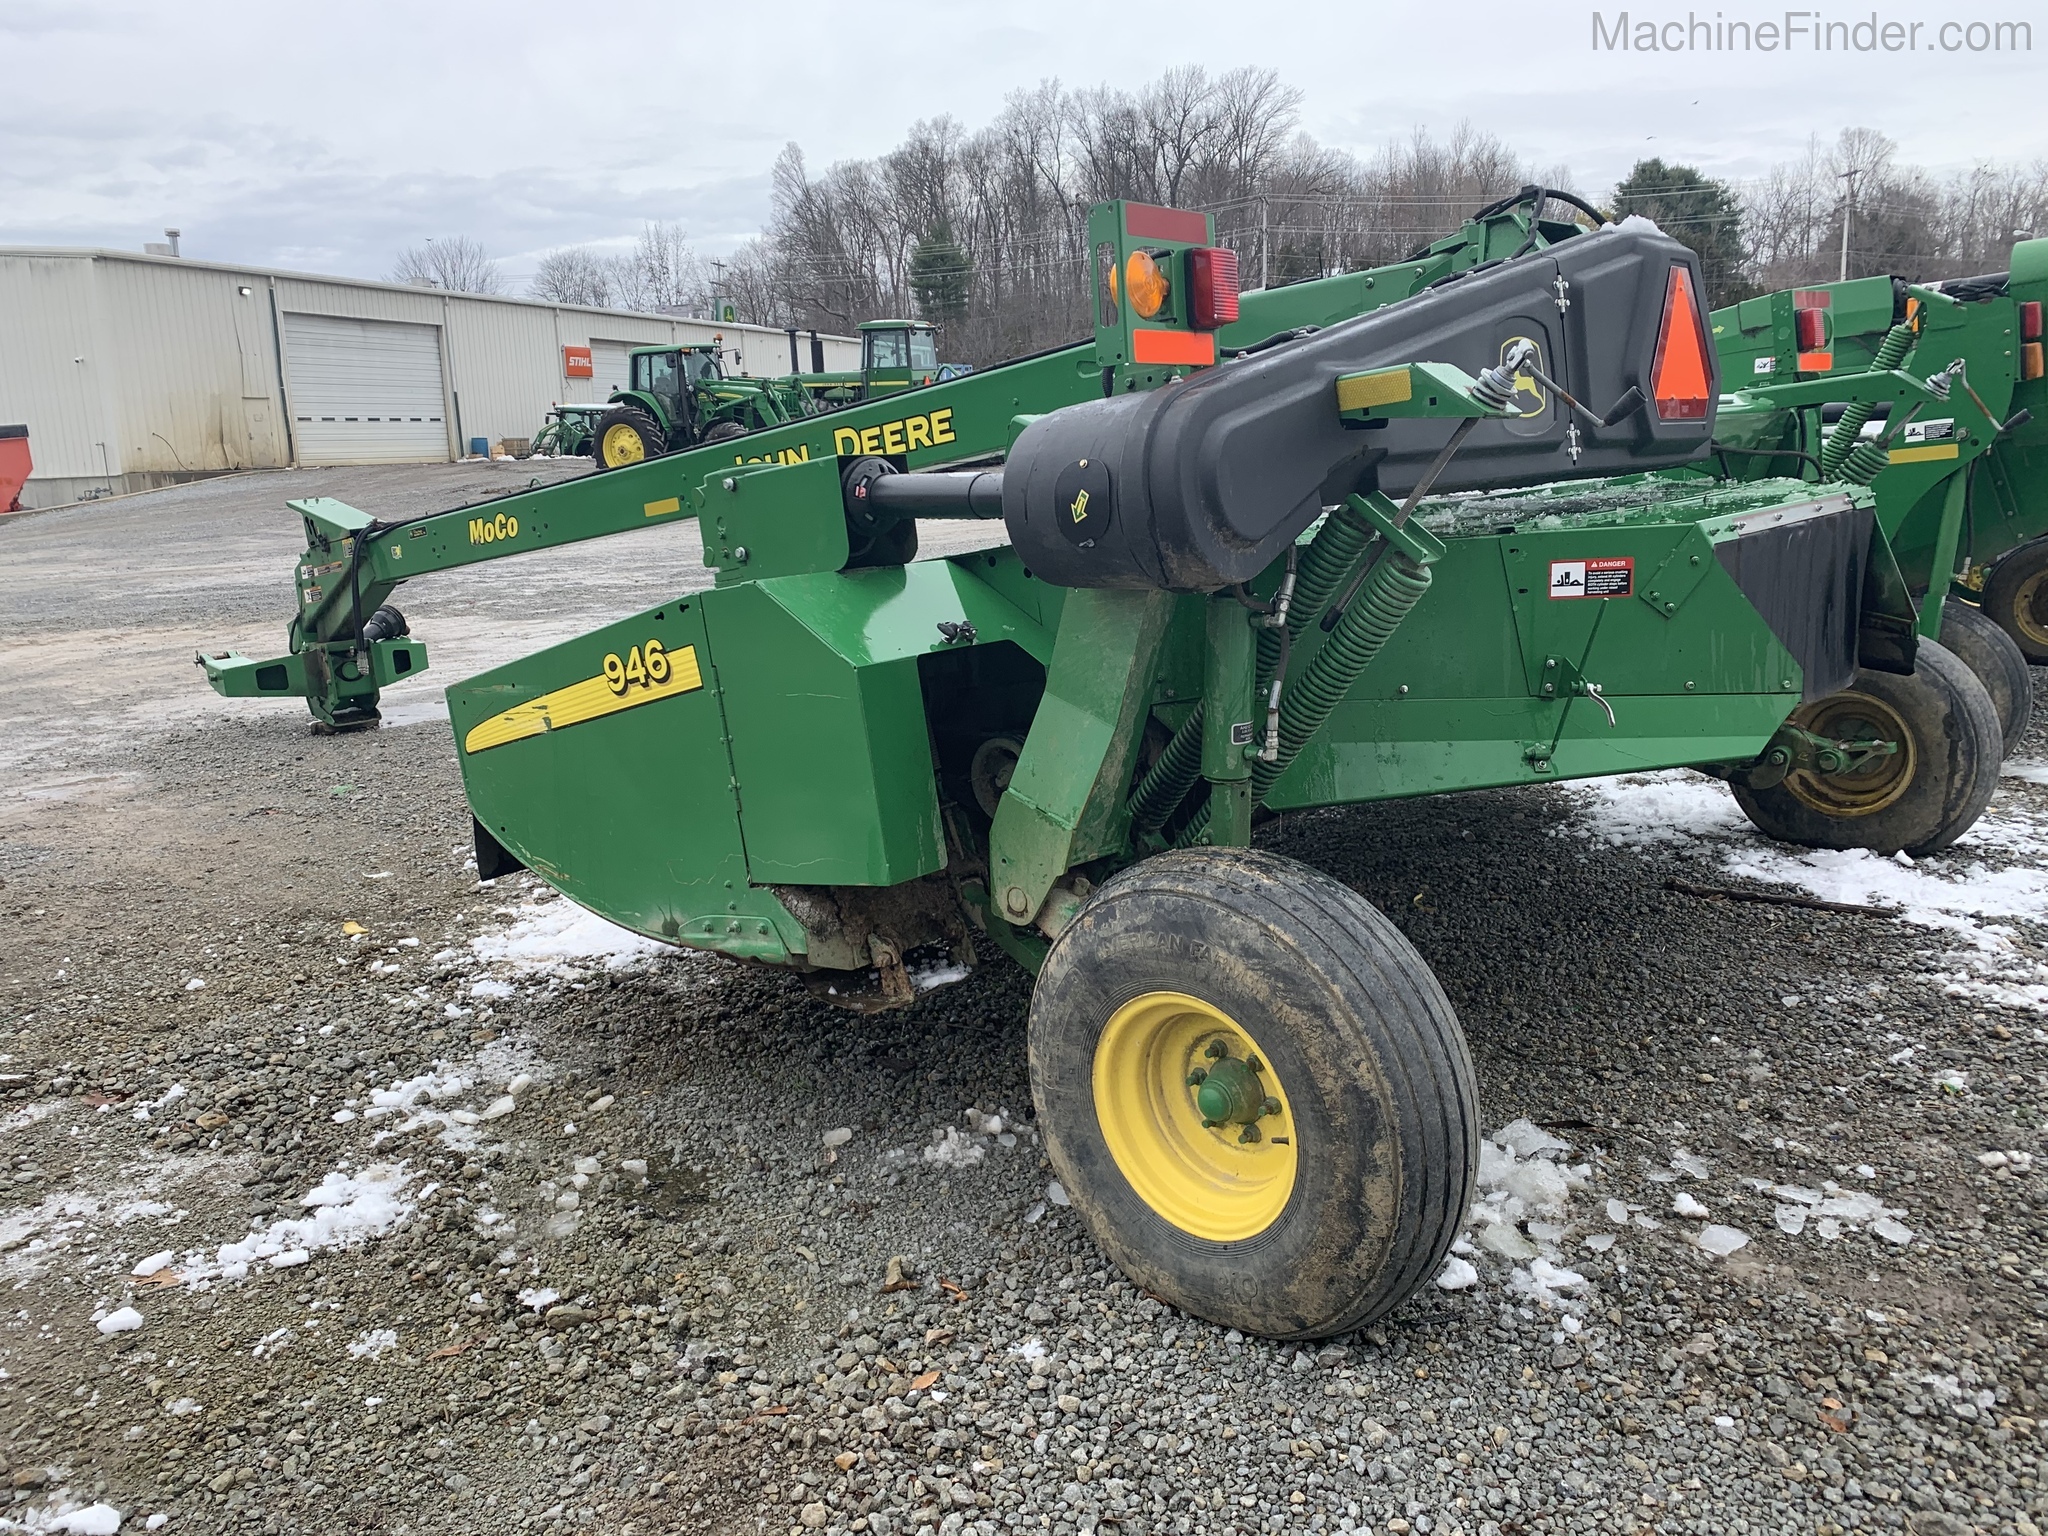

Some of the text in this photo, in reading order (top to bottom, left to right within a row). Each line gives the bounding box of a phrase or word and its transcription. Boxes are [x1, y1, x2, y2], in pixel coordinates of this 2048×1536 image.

[569, 356, 592, 367] STIHL
[735, 407, 956, 467] HN DEERE
[468, 512, 519, 545] MoCo
[603, 638, 670, 696] 946
